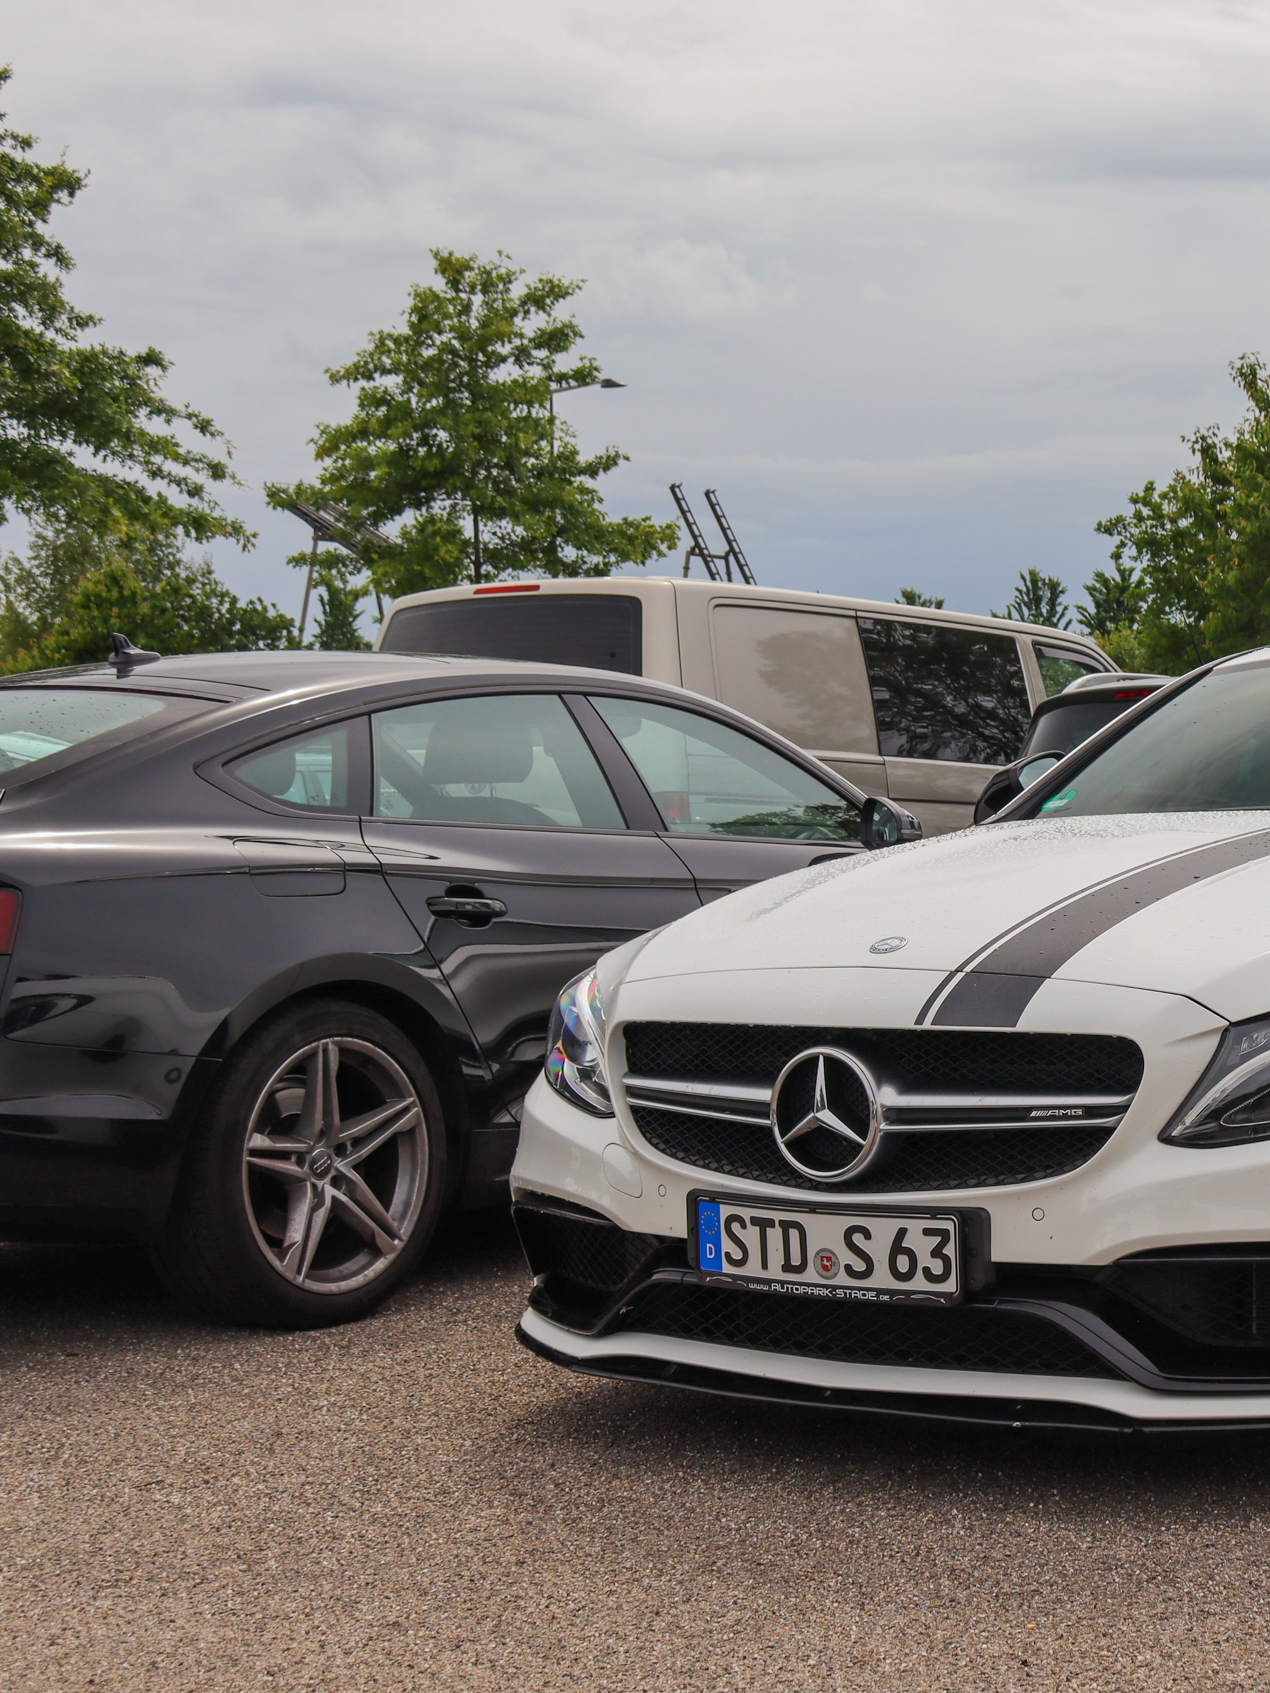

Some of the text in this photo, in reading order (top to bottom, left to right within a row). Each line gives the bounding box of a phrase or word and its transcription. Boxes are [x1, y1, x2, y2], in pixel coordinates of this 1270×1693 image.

[1047, 1108, 1083, 1117] AMG
[706, 1243, 716, 1259] D
[723, 1212, 809, 1274] STD
[843, 1224, 875, 1280] S
[887, 1226, 952, 1284] 63
